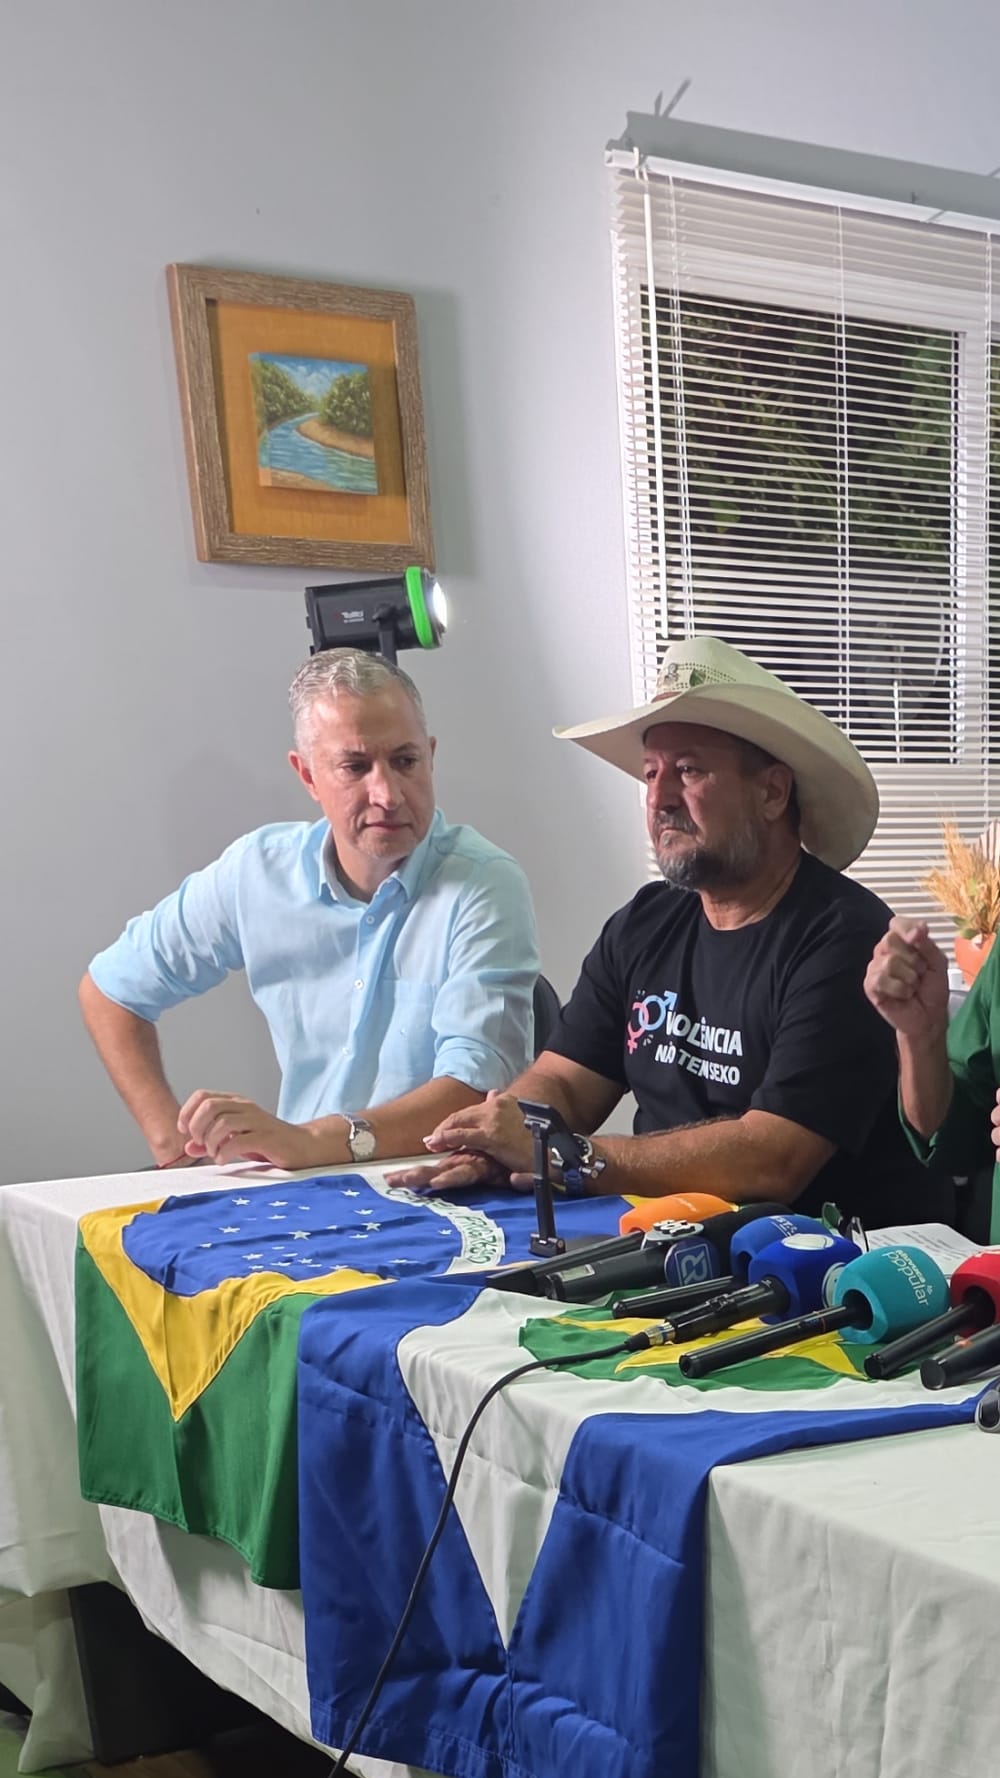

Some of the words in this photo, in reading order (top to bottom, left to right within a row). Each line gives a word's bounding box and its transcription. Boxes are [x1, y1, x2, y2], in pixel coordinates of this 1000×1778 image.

[666, 1011, 743, 1056] VOLÊNCIA
[709, 1062, 740, 1086] SEXO
[881, 1251, 929, 1305] popular
